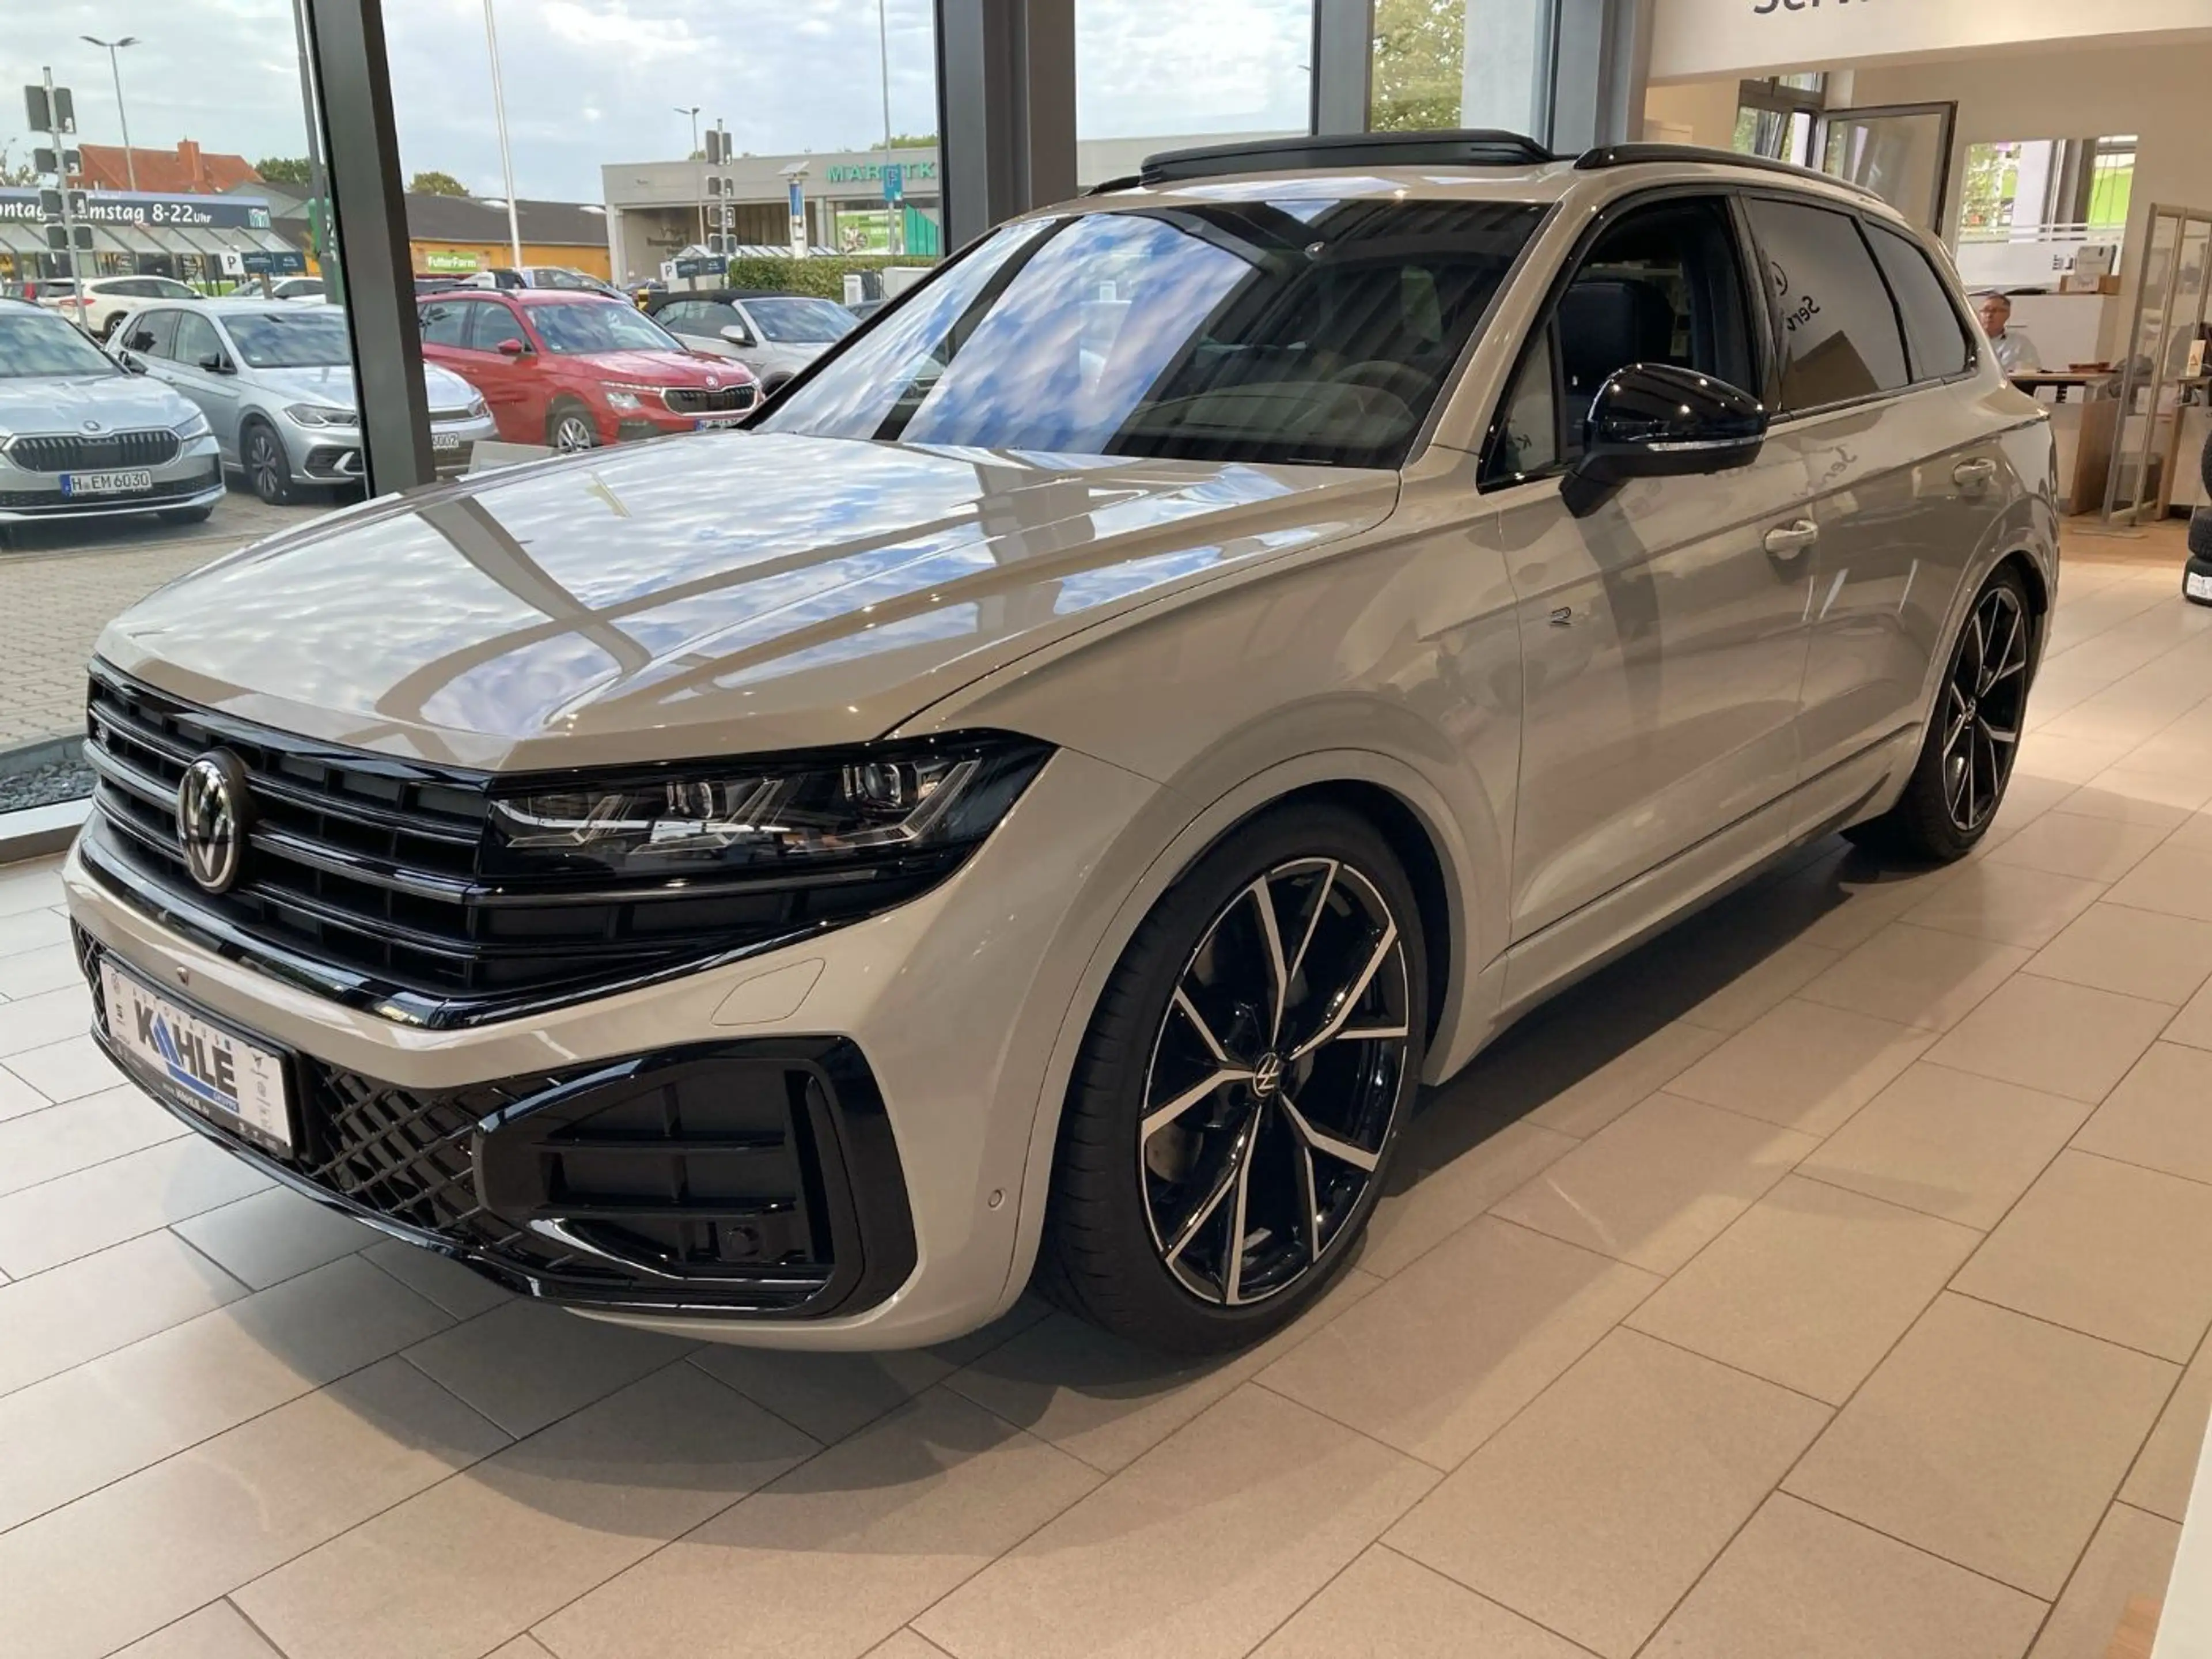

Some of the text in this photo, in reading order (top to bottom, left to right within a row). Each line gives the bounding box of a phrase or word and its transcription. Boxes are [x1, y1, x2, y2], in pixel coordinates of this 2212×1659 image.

[828, 162, 937, 183] MARTK
[0, 202, 47, 221] ntag
[72, 474, 149, 490] H EM 6030
